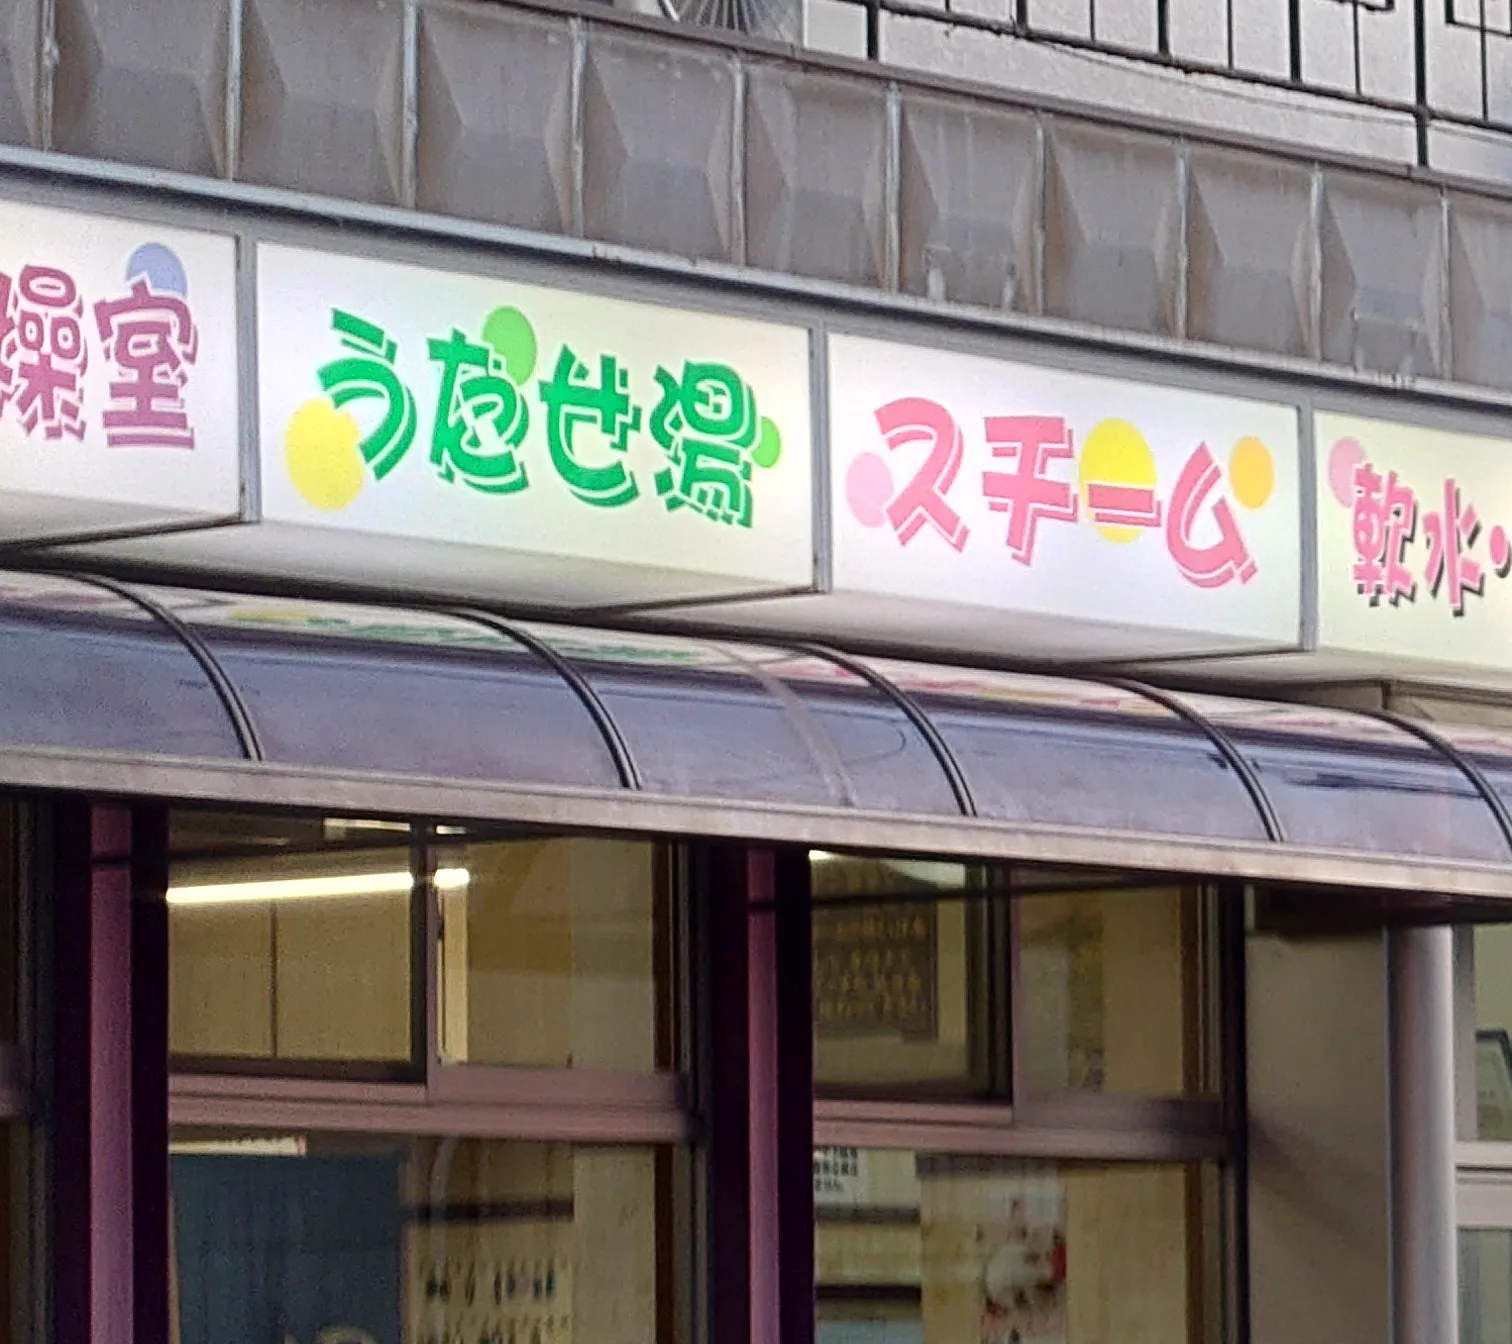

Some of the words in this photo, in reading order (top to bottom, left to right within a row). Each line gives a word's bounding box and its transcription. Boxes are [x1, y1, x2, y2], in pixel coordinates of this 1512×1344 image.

[316, 307, 762, 529] うたせ湯
[873, 397, 1259, 590] スチーム
